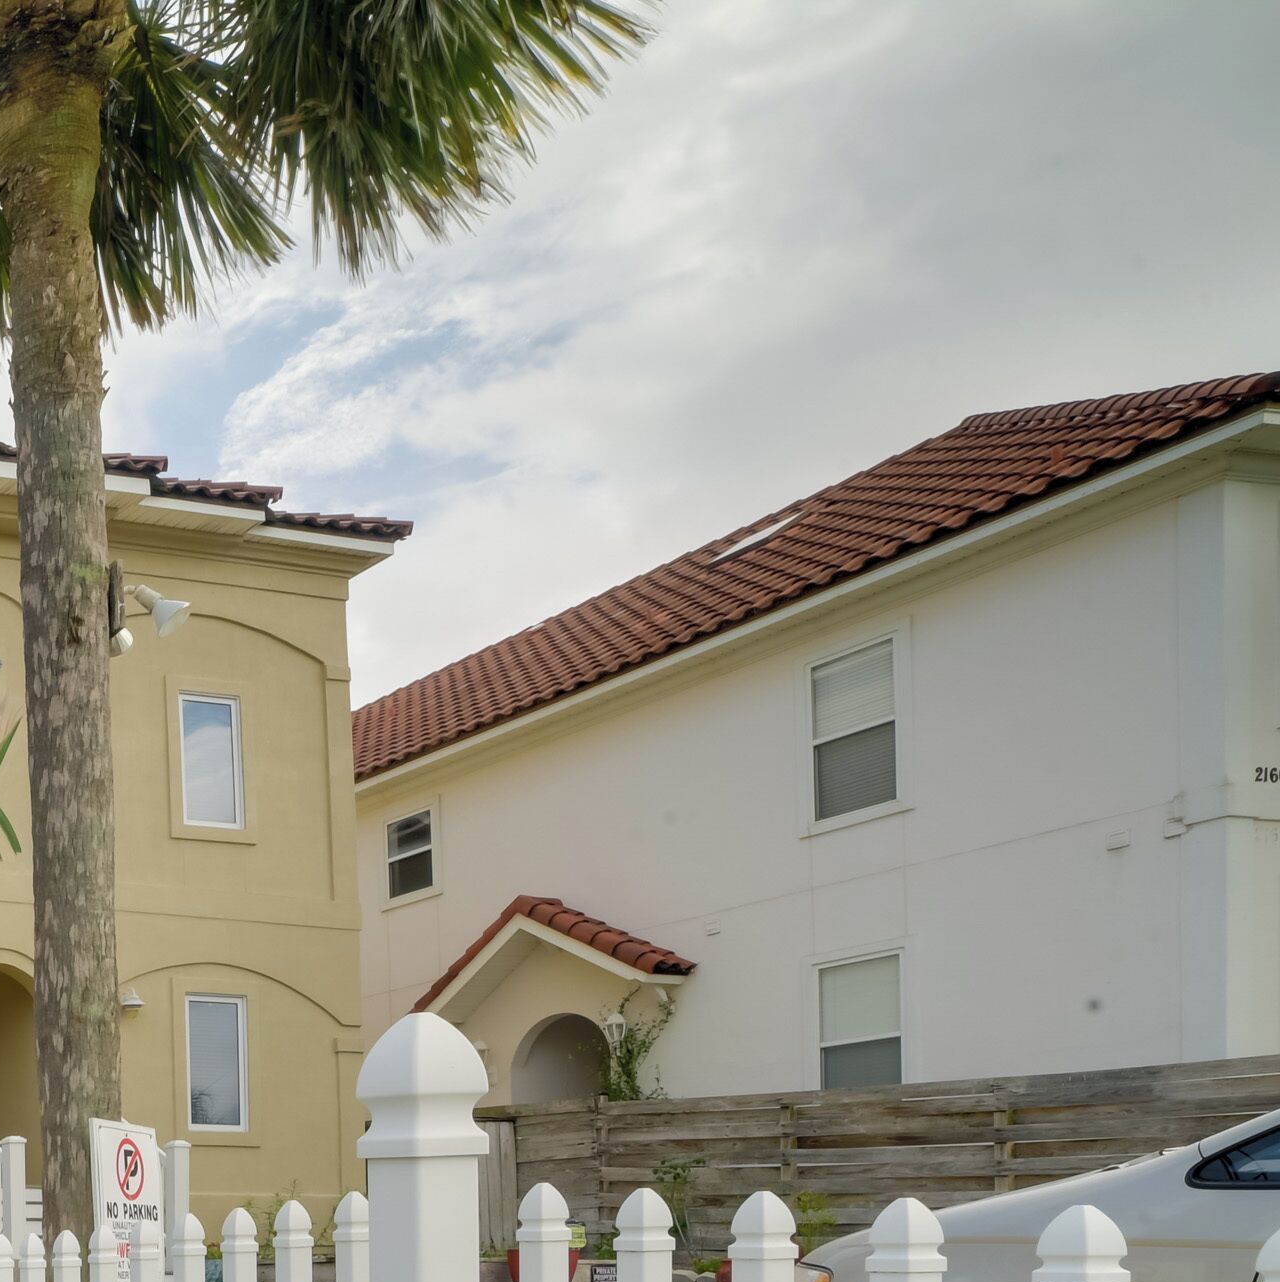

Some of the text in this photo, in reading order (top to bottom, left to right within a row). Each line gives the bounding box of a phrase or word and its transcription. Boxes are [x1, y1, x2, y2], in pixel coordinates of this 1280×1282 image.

[1255, 766, 1280, 784] 216
[106, 1201, 159, 1222] NO PARKING
